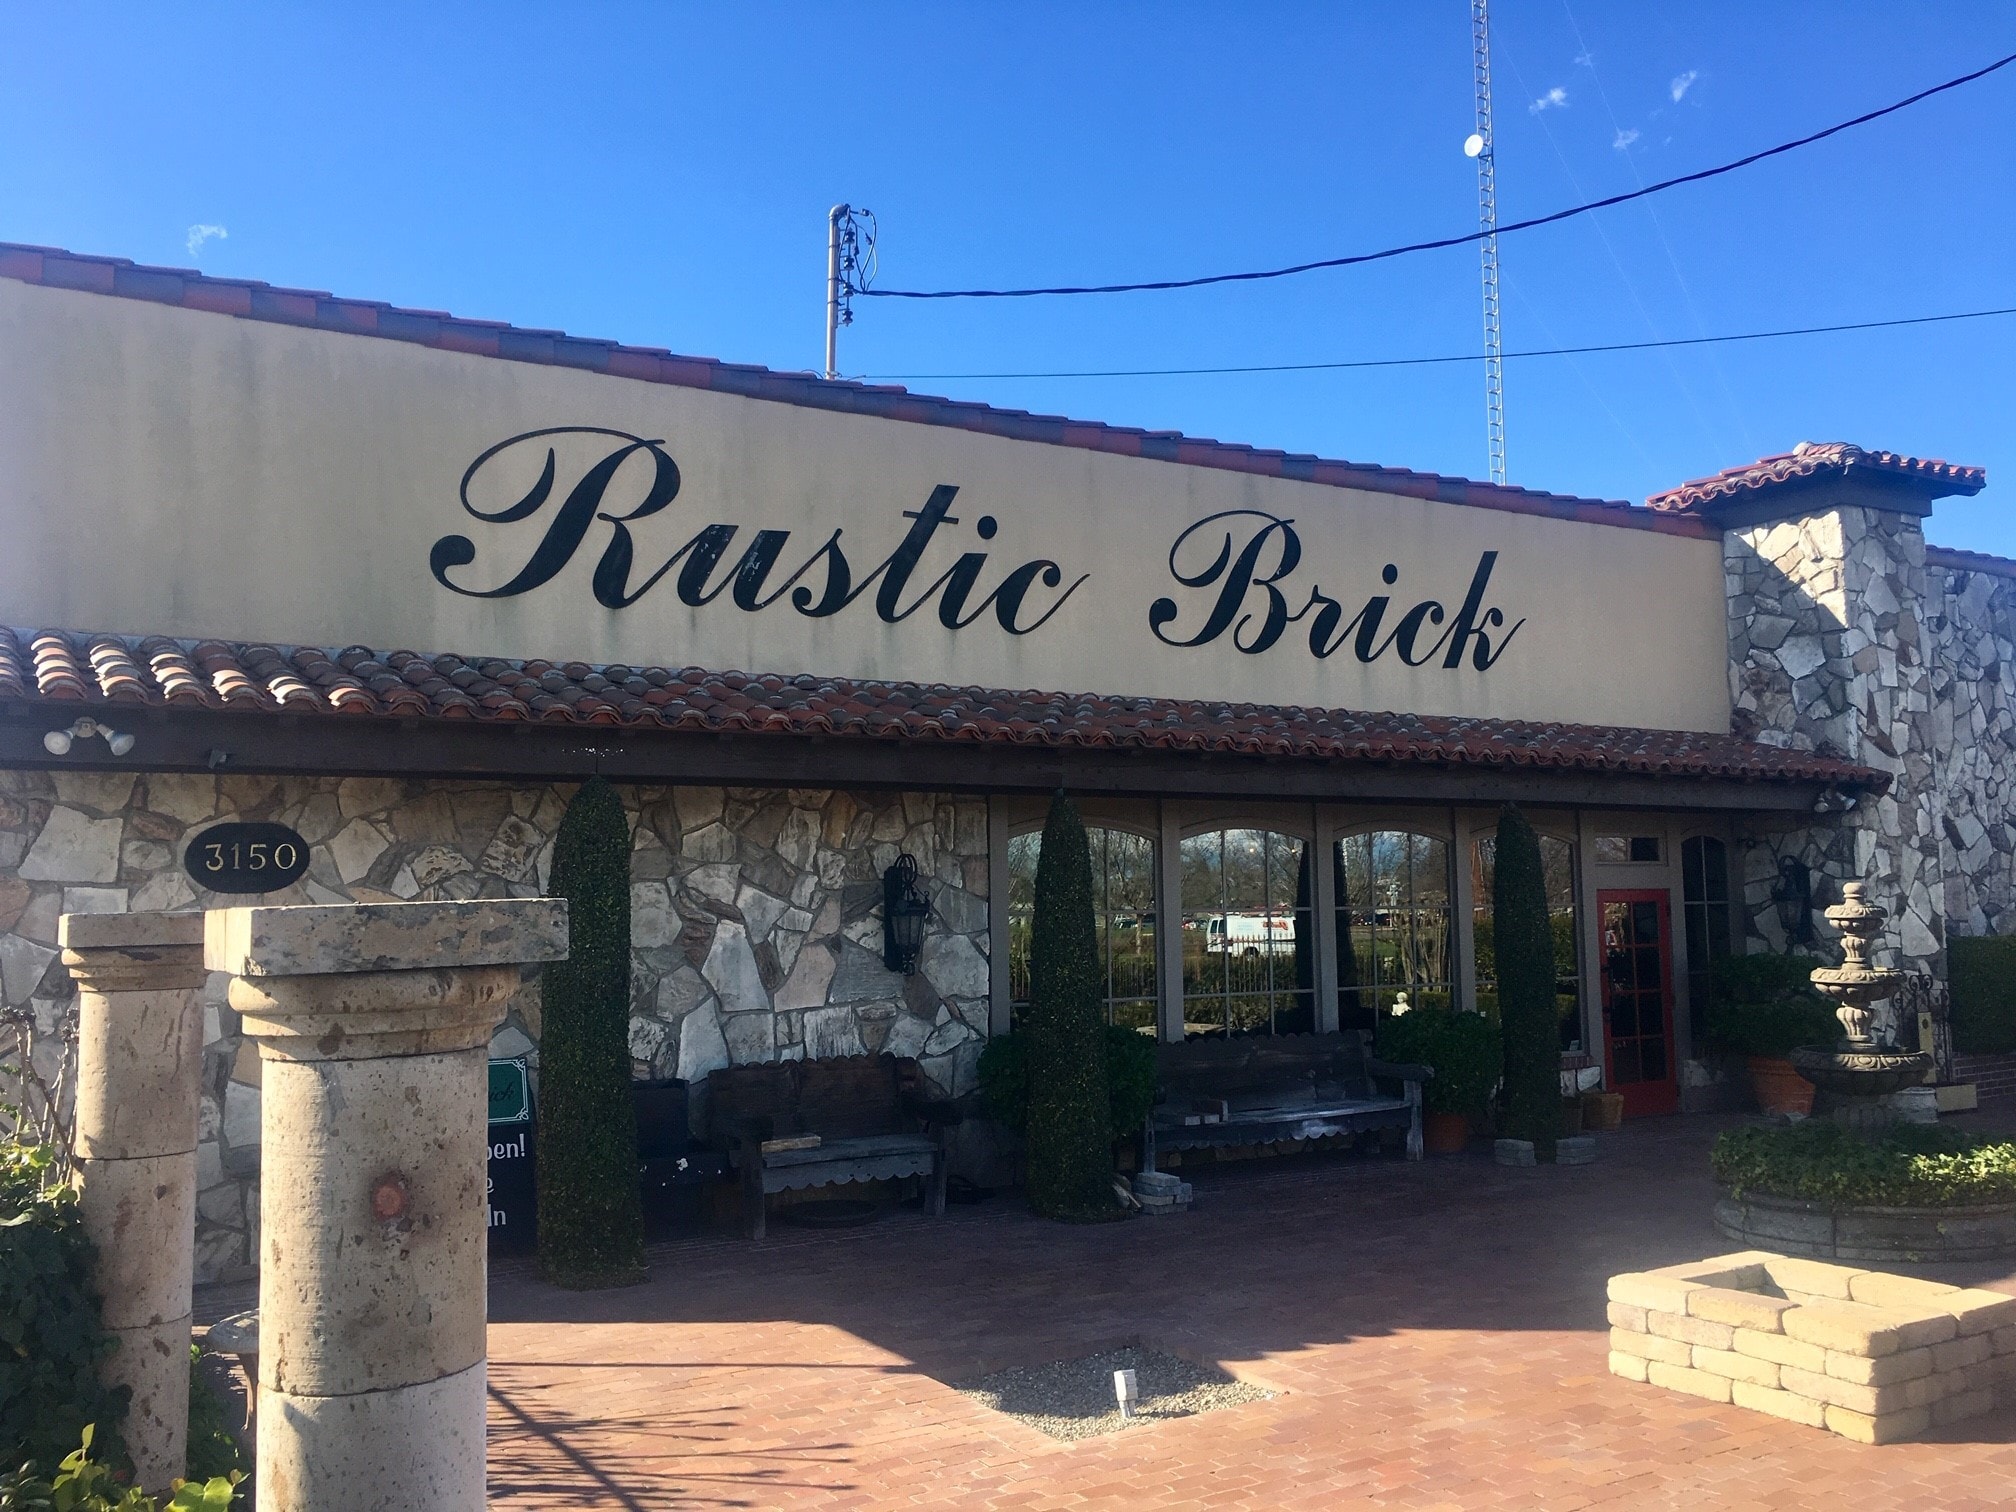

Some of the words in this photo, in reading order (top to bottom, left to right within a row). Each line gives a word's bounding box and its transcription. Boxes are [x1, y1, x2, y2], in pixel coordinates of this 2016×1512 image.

[430, 427, 1090, 635] Rustic
[1149, 510, 1526, 671] Brick
[205, 843, 297, 871] 3150
